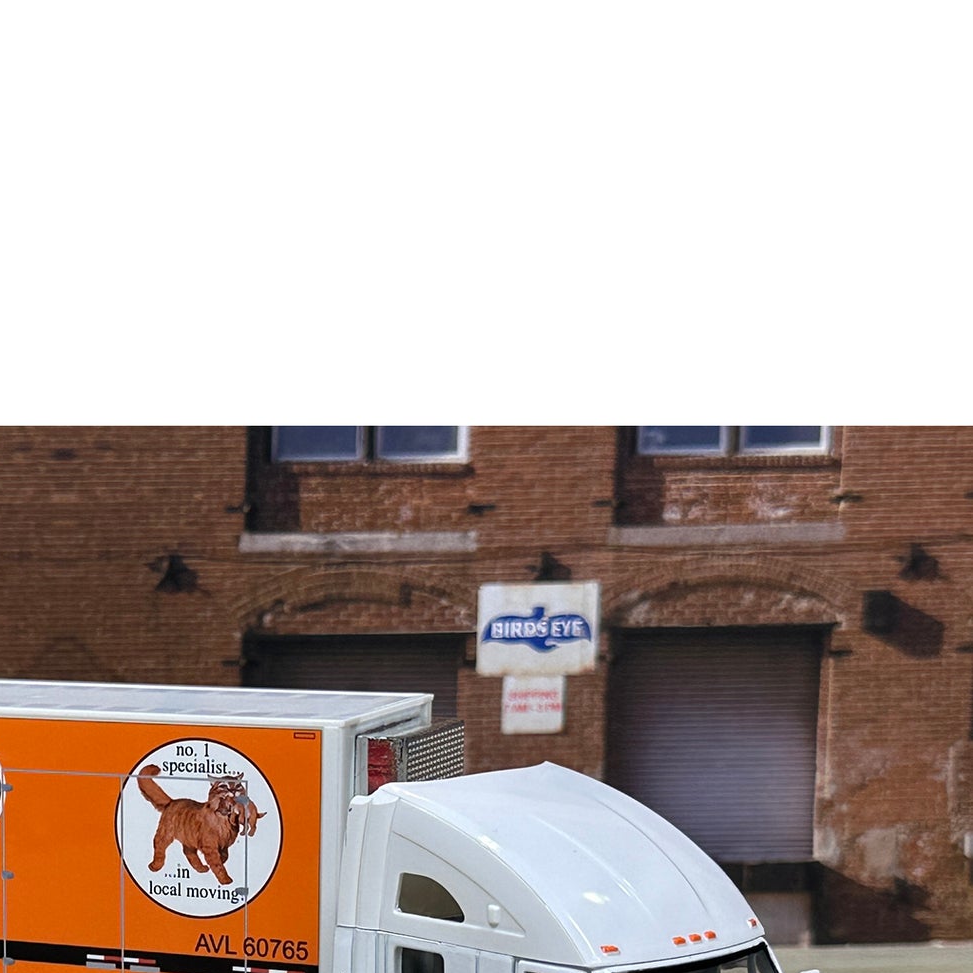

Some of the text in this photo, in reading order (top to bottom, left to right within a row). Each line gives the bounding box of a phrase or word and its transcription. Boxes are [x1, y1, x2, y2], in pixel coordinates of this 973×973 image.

[551, 621, 584, 637] EYE
[176, 744, 198, 757] no.
[149, 881, 181, 897] local
[194, 933, 309, 961] AVL 60765
